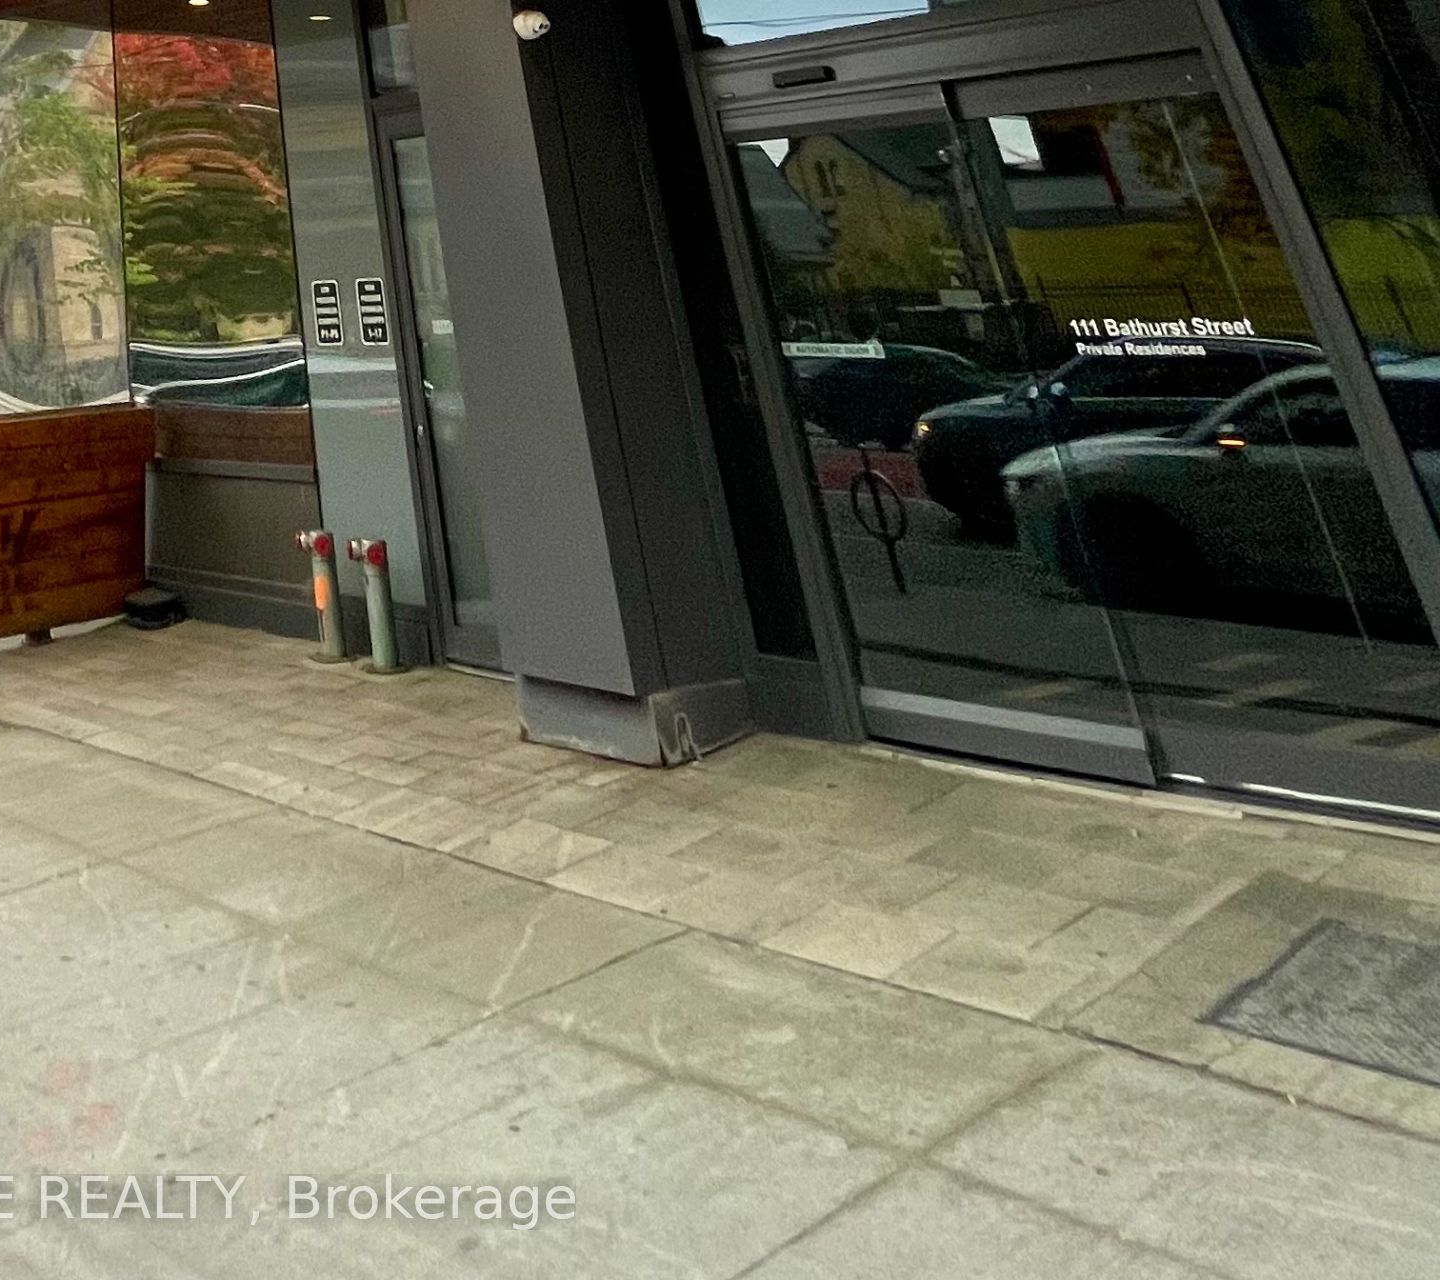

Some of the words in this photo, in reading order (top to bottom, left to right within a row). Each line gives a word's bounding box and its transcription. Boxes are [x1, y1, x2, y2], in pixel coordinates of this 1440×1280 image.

[1070, 318, 1101, 337] 111
[1103, 317, 1190, 337] Bathurst
[1191, 315, 1256, 336] Street
[1075, 342, 1123, 356] Private
[1124, 342, 1207, 356] Residences
